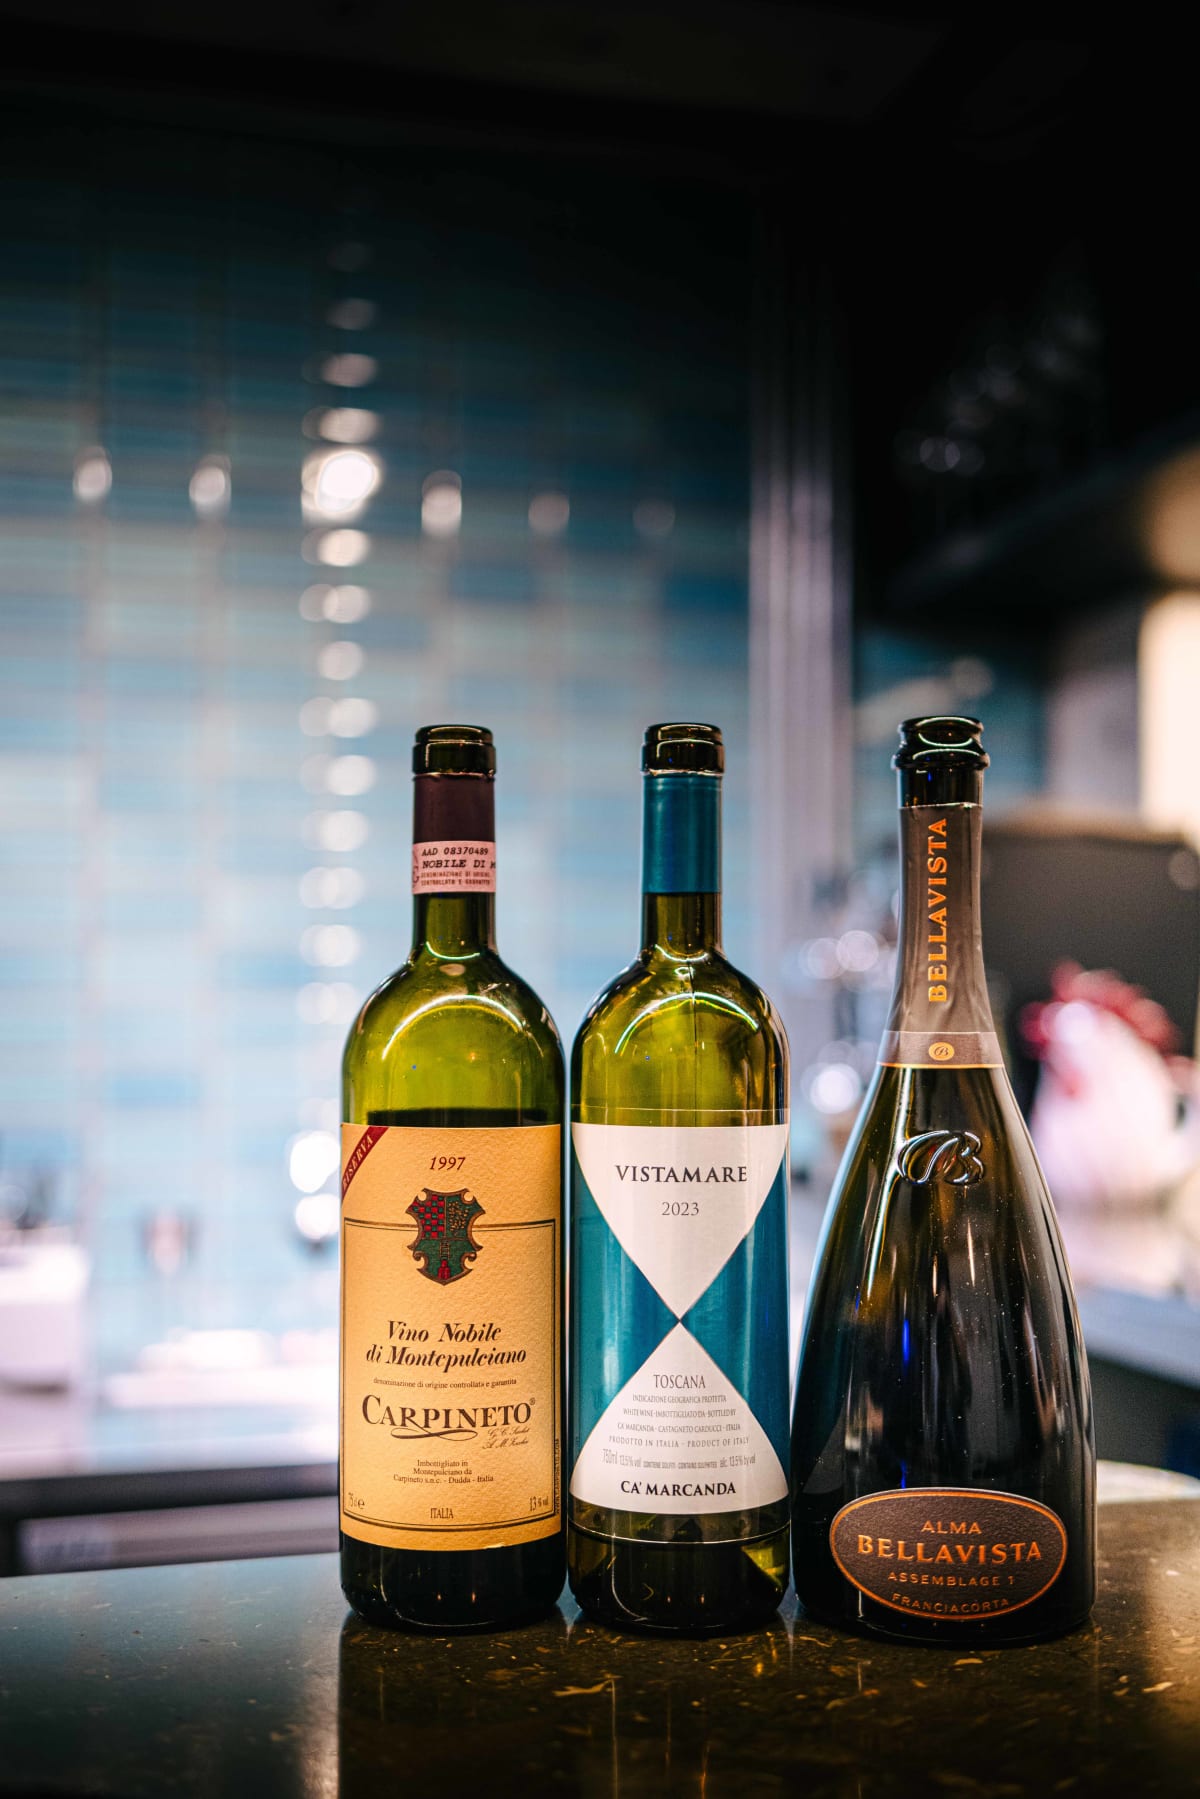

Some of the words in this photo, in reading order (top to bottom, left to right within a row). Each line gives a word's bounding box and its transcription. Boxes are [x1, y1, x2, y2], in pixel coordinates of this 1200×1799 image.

[421, 847, 438, 857] AAD
[443, 846, 489, 856] 08370489
[422, 859, 467, 869] NOBILE
[473, 860, 486, 868] DI
[928, 818, 948, 1002] BELLAVISTA
[429, 1156, 466, 1171] 1997
[615, 1164, 748, 1183] VISTAMARE
[661, 1201, 700, 1216] 2023
[388, 1320, 429, 1343] Vino
[438, 1323, 502, 1343] Nobile
[366, 1344, 384, 1363] di
[386, 1345, 527, 1374] Montepulciano
[425, 1382, 448, 1390] origine
[450, 1381, 485, 1389] controllata
[491, 1378, 517, 1388] garantita
[653, 1374, 706, 1389] TOSCANA
[362, 1394, 532, 1430] CARPINETO
[645, 1439, 654, 1447] IN
[656, 1440, 680, 1448] ITALIA
[687, 1439, 720, 1448] PRODUCT
[722, 1438, 731, 1446] OF
[733, 1437, 750, 1446] ITALY
[413, 1467, 463, 1476] Montepulciano
[464, 1467, 473, 1475] da
[417, 1459, 460, 1469] Imbottigliato
[393, 1474, 423, 1484] Carpineto
[448, 1476, 471, 1484] Dudda
[477, 1474, 494, 1483] Italia
[645, 1482, 737, 1497] MARCANDA
[430, 1507, 454, 1519] ITALIA
[920, 1519, 983, 1535] ALMA
[857, 1534, 1042, 1565] BELLAVISTA
[887, 1571, 1001, 1587] ASSEMBLAGE
[1007, 1575, 1015, 1585] 1
[891, 1592, 1010, 1615] FRANCIACORTA
